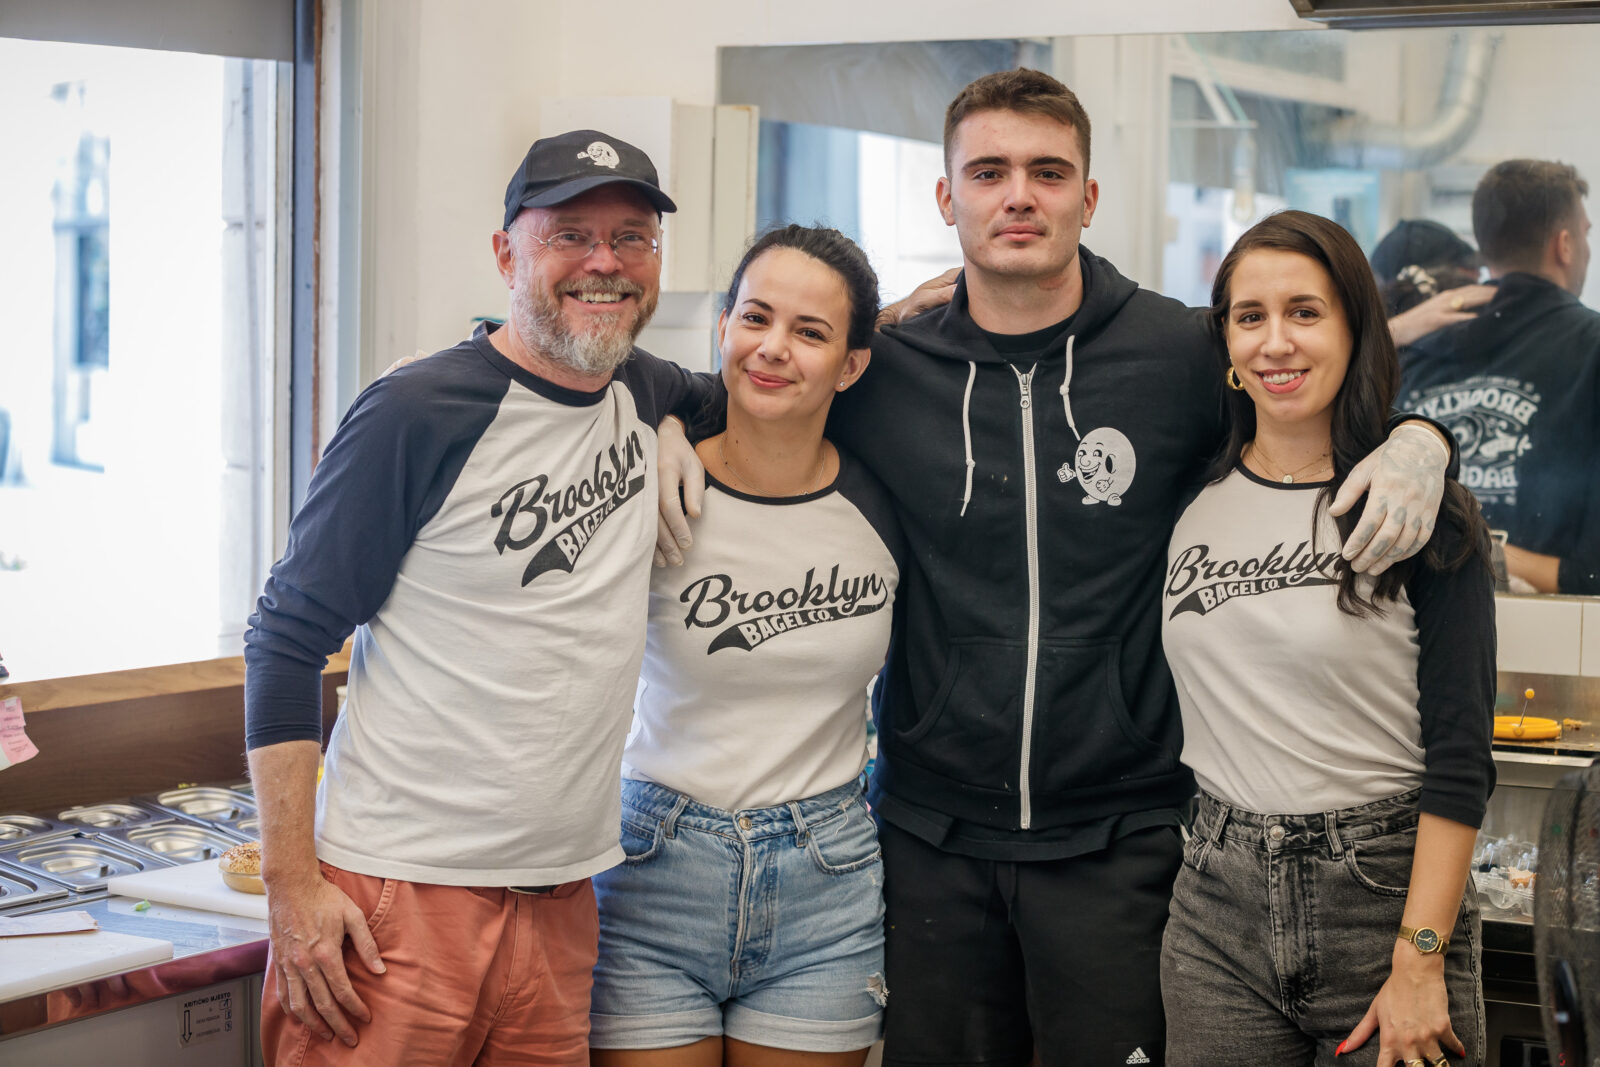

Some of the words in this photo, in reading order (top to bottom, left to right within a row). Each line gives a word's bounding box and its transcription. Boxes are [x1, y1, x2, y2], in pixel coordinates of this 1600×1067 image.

[491, 430, 644, 556] Brooklyn
[680, 563, 887, 630] Brooklyn
[1197, 581, 1260, 612] BAGEL
[1260, 579, 1280, 592] CO.
[738, 609, 808, 647] BAGEL
[808, 607, 834, 623] CO.
